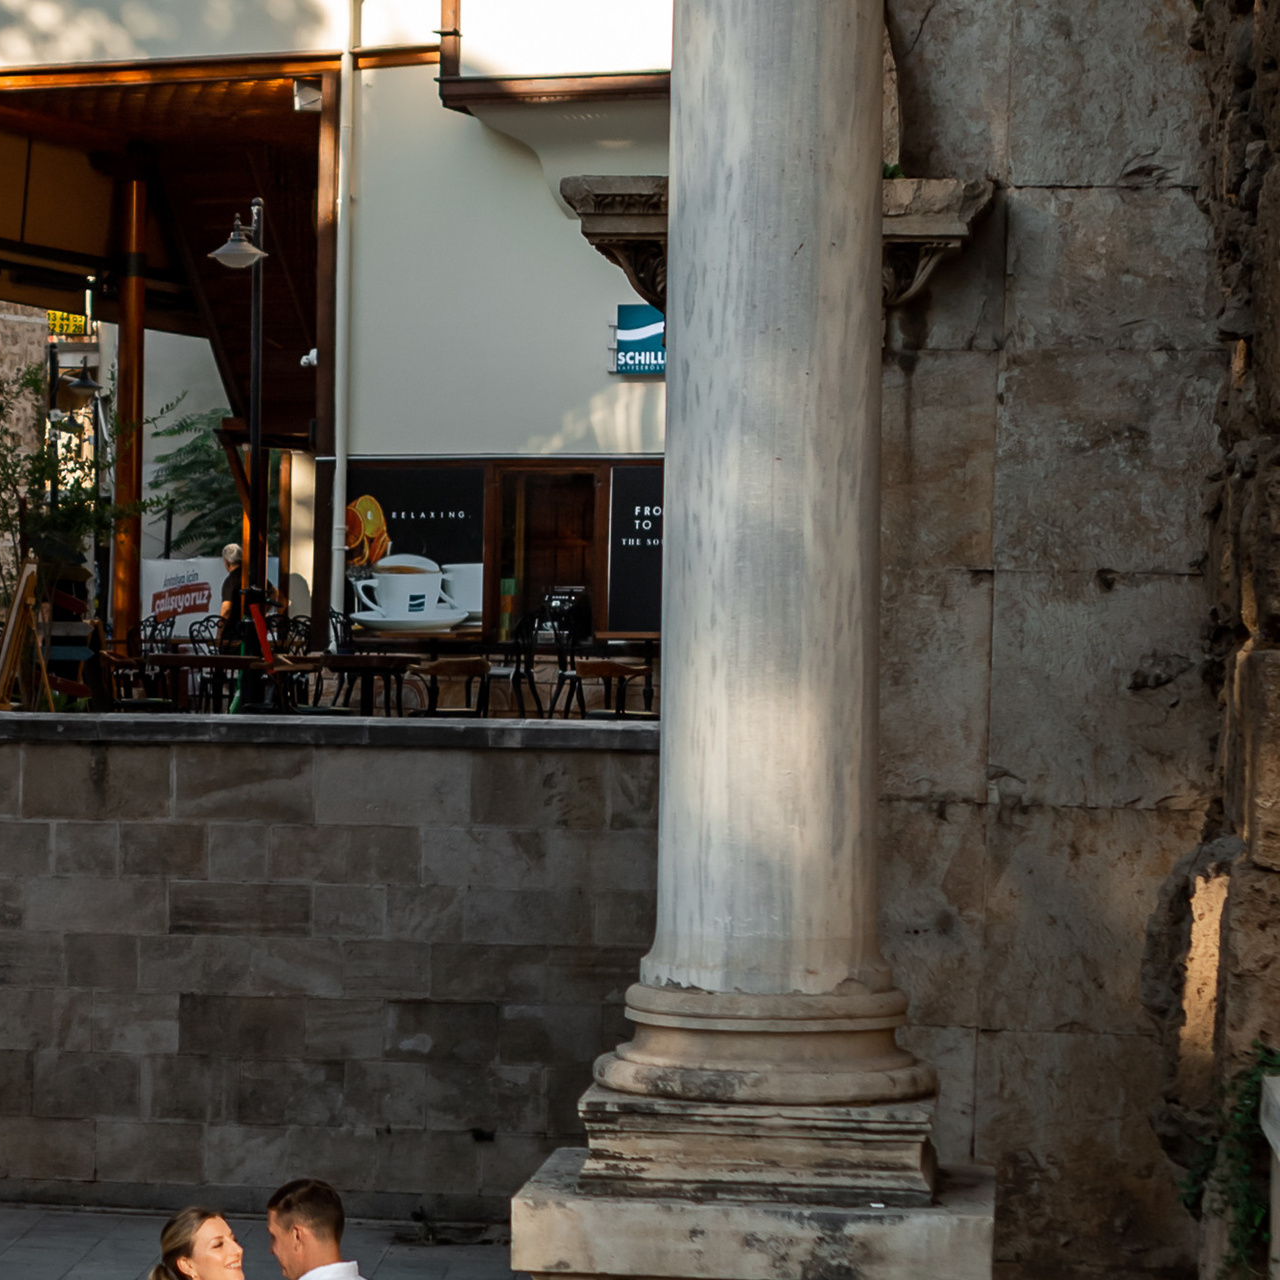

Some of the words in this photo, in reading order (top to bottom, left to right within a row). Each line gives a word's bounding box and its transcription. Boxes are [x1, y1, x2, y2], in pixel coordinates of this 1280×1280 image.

[617, 351, 667, 365] SCHILL
[634, 506, 663, 516] FRO
[634, 520, 652, 530] TO
[621, 538, 641, 546] THE
[646, 538, 663, 546] SO
